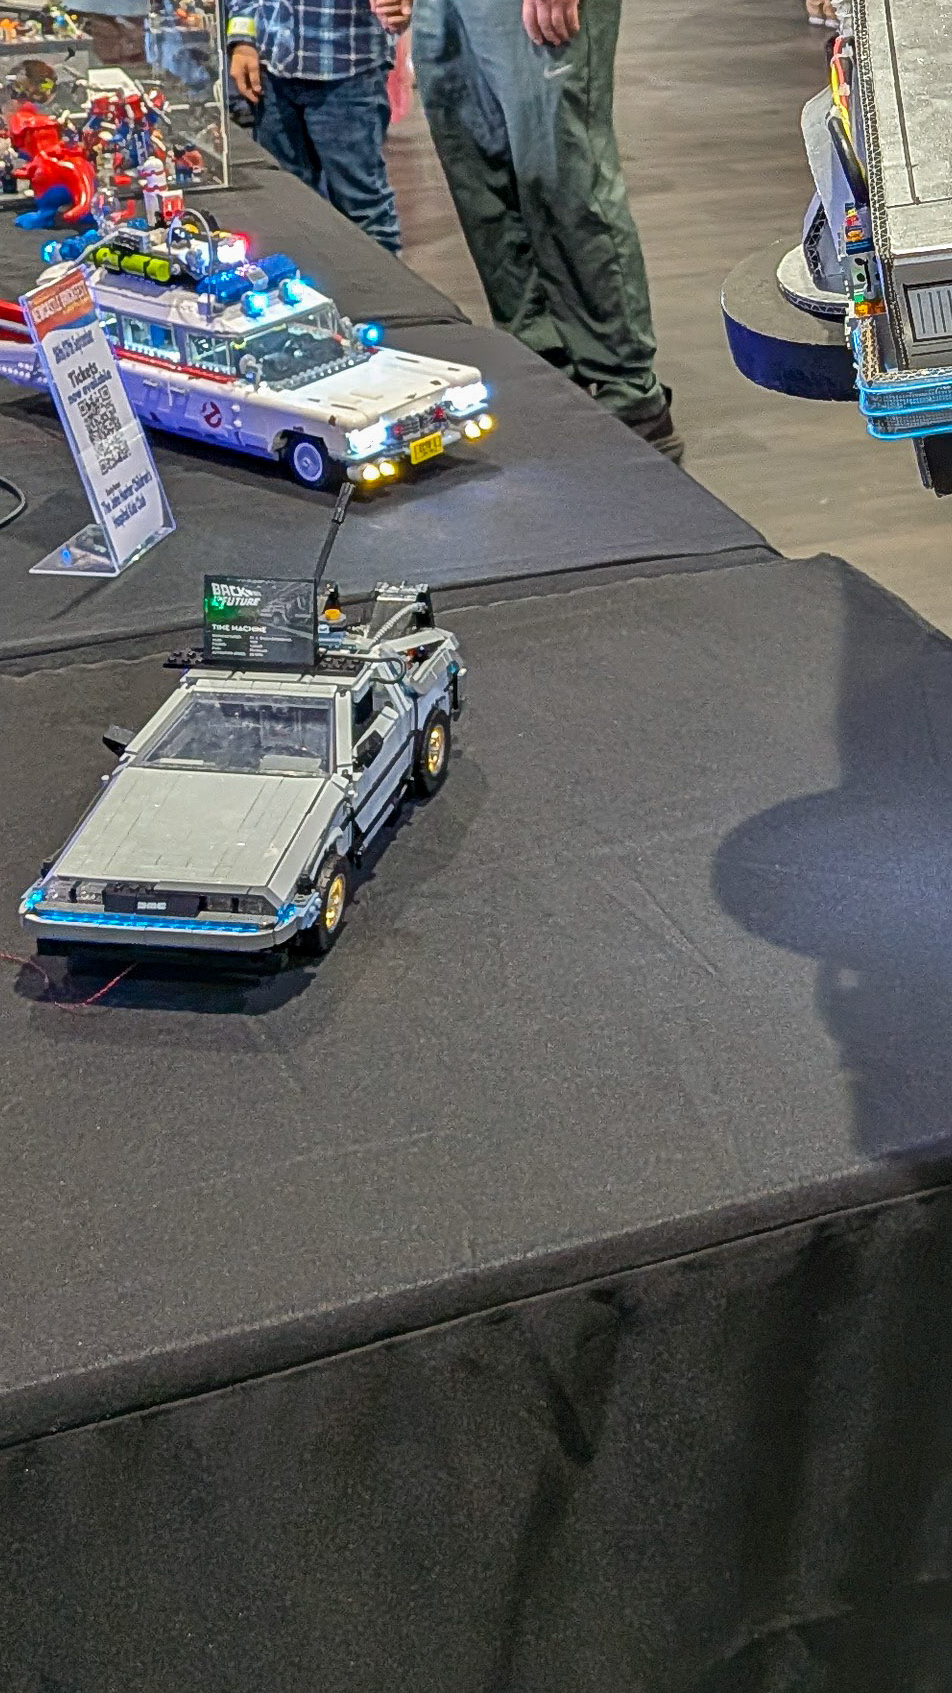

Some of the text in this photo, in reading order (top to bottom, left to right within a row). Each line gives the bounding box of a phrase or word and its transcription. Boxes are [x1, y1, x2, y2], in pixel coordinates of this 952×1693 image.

[67, 362, 99, 389] Tickets
[82, 369, 113, 396] available
[211, 582, 250, 597] BACK
[222, 597, 261, 607] FUTURE
[212, 623, 267, 634] TIME MACHINE
